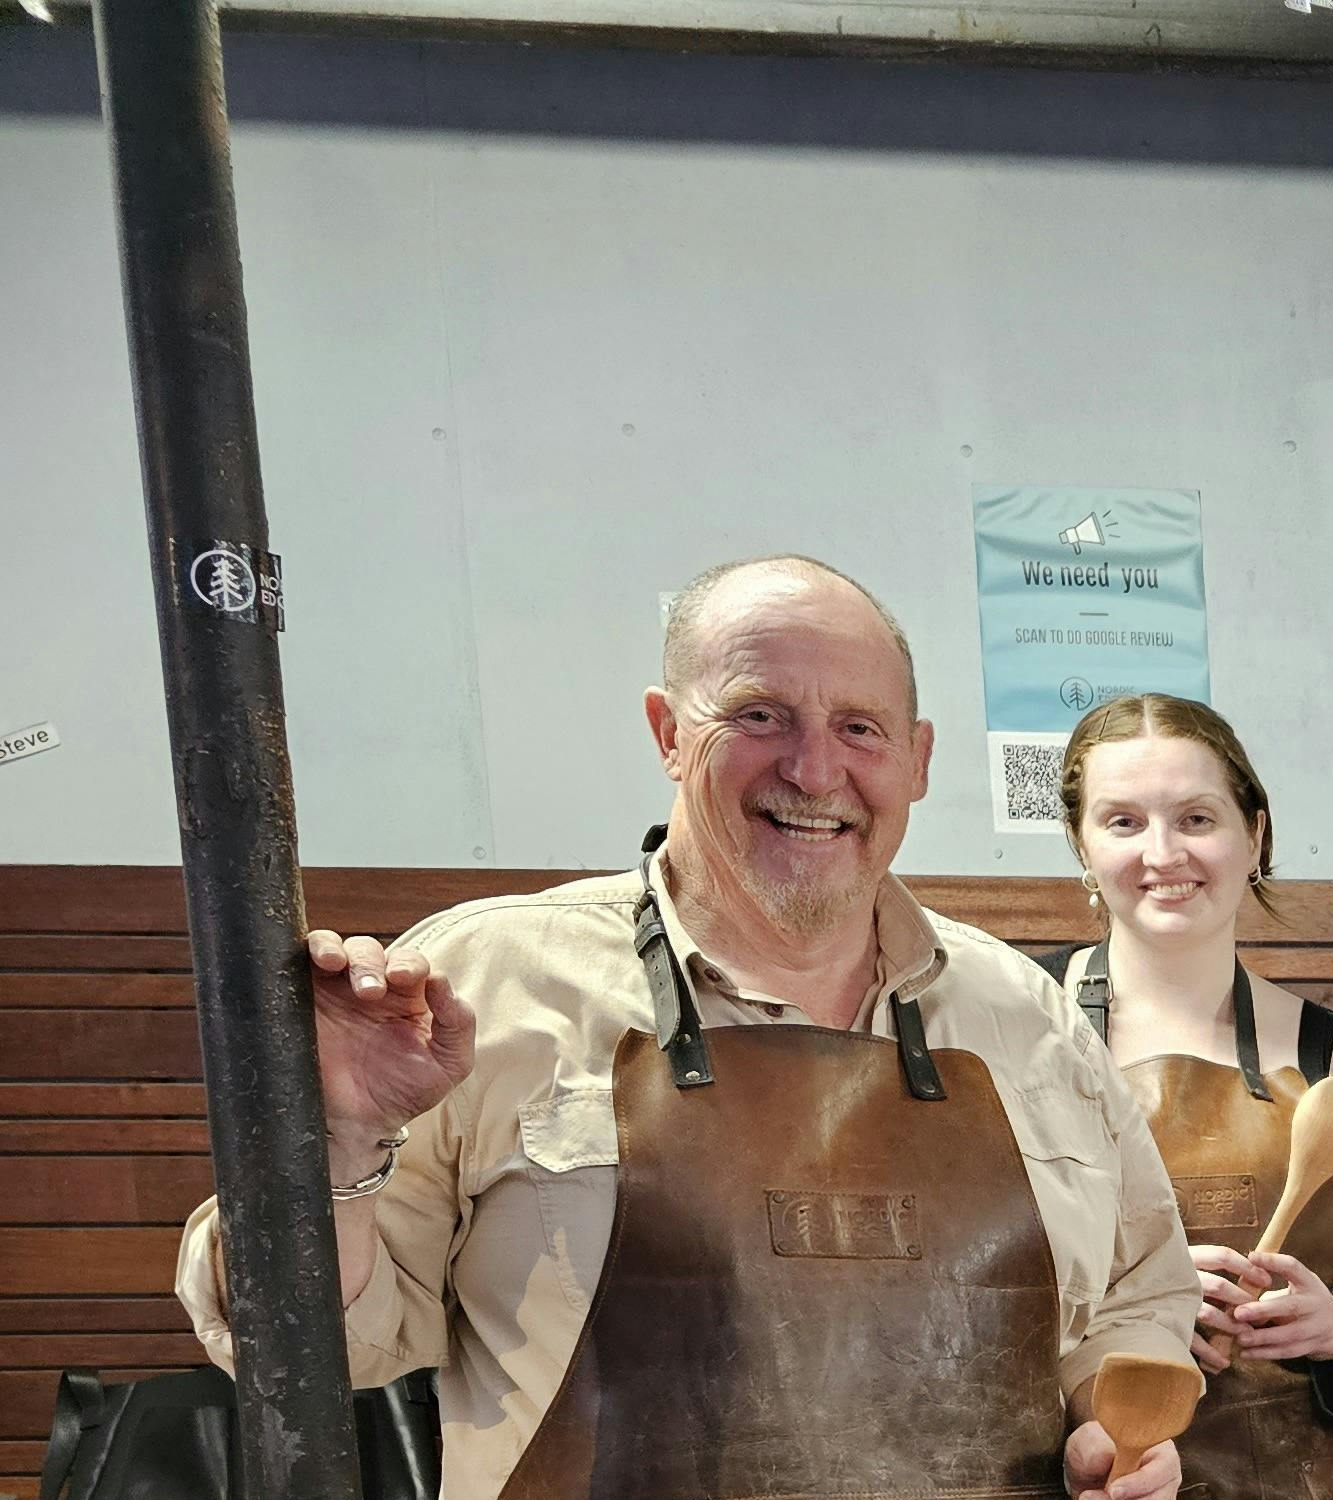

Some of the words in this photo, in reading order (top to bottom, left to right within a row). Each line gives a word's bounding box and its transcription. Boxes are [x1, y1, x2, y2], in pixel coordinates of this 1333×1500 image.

[1022, 560, 1054, 586] We
[1060, 561, 1110, 588] need
[1121, 567, 1159, 594] you
[1015, 627, 1047, 644] SCAN
[1050, 629, 1064, 645] TO
[1068, 629, 1082, 645] DO
[1085, 630, 1127, 646] GOOGLE
[1130, 631, 1174, 648] REVIEW
